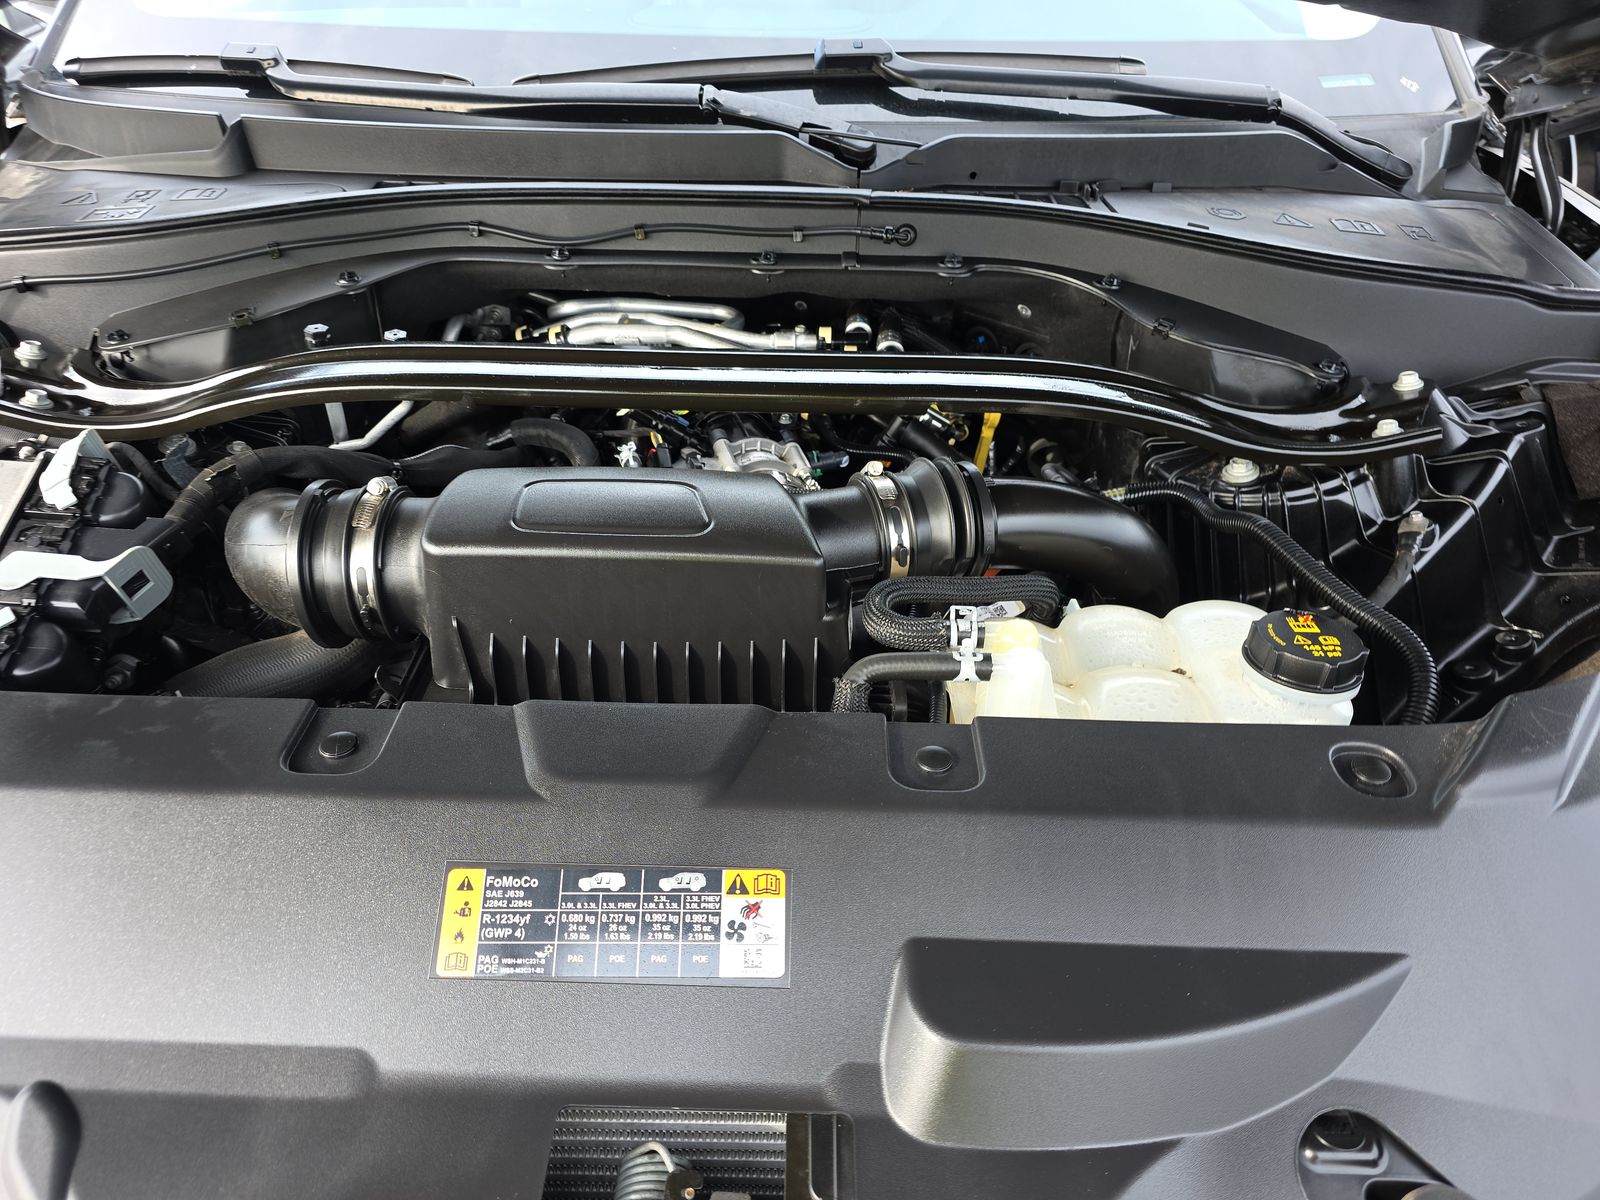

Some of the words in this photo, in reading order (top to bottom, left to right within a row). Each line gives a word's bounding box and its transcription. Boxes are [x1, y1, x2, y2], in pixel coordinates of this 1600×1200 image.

[486, 876, 539, 888] FoMoCo
[485, 890, 503, 898] SAE
[504, 890, 525, 898] J639
[484, 900, 507, 908] J2842
[508, 900, 533, 908] J2845
[483, 913, 531, 926] R-1234yf
[561, 914, 583, 923] 0.680
[585, 914, 596, 924] kg
[601, 914, 623, 923] 0.737
[625, 914, 636, 924] kg
[645, 913, 667, 922] 0.992
[668, 914, 679, 924] kg
[685, 914, 707, 923] 0.992
[708, 914, 720, 925] kg
[692, 924, 701, 932] 35
[481, 928, 512, 939] (GWP
[514, 928, 526, 939] 4)
[647, 932, 663, 940] 2.19
[688, 933, 703, 941] 2.19
[703, 933, 715, 941] lbs
[478, 954, 499, 965] PAG
[567, 955, 584, 963] PAG
[609, 955, 625, 963] POE
[650, 955, 667, 963] PAG
[692, 955, 709, 963] POE
[477, 964, 499, 974] POE
